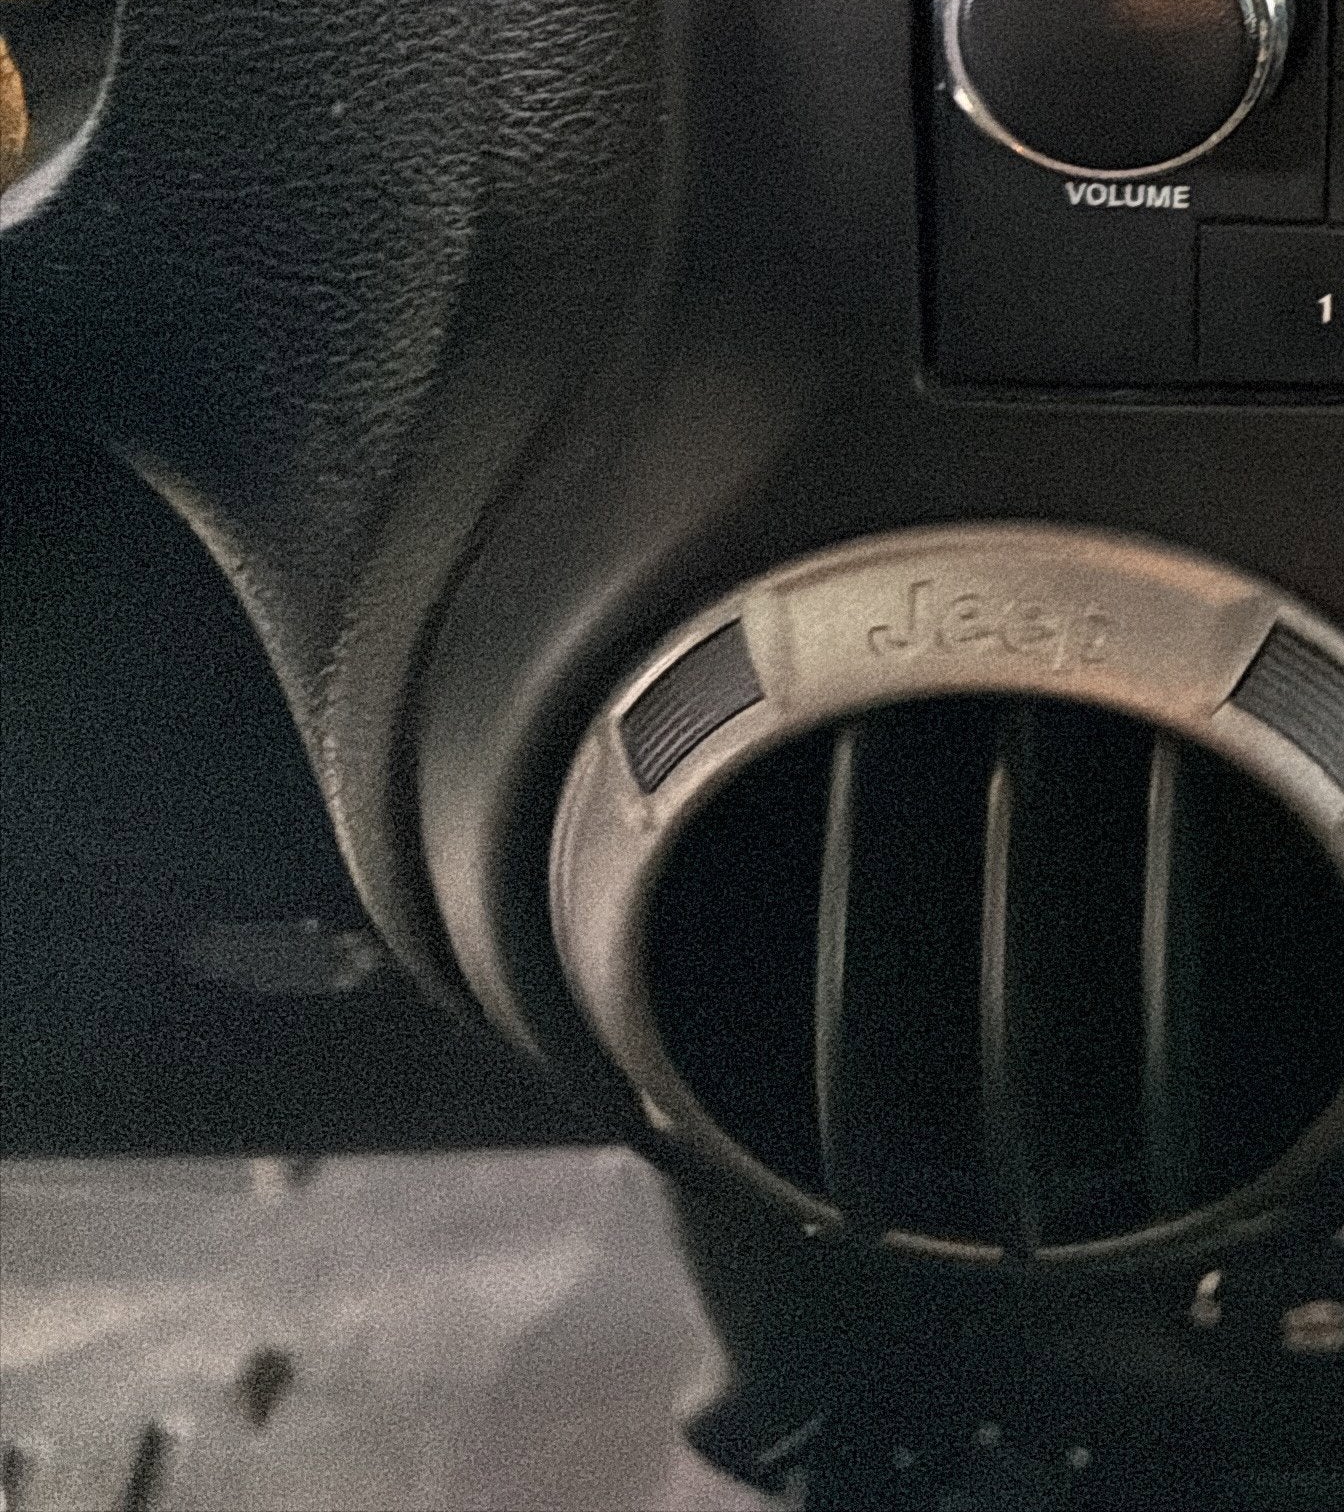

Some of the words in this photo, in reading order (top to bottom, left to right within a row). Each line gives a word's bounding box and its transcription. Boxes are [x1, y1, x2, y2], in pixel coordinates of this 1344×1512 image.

[1064, 181, 1191, 210] VOLUME
[1317, 293, 1333, 324] 1
[867, 578, 1114, 672] Jeep
